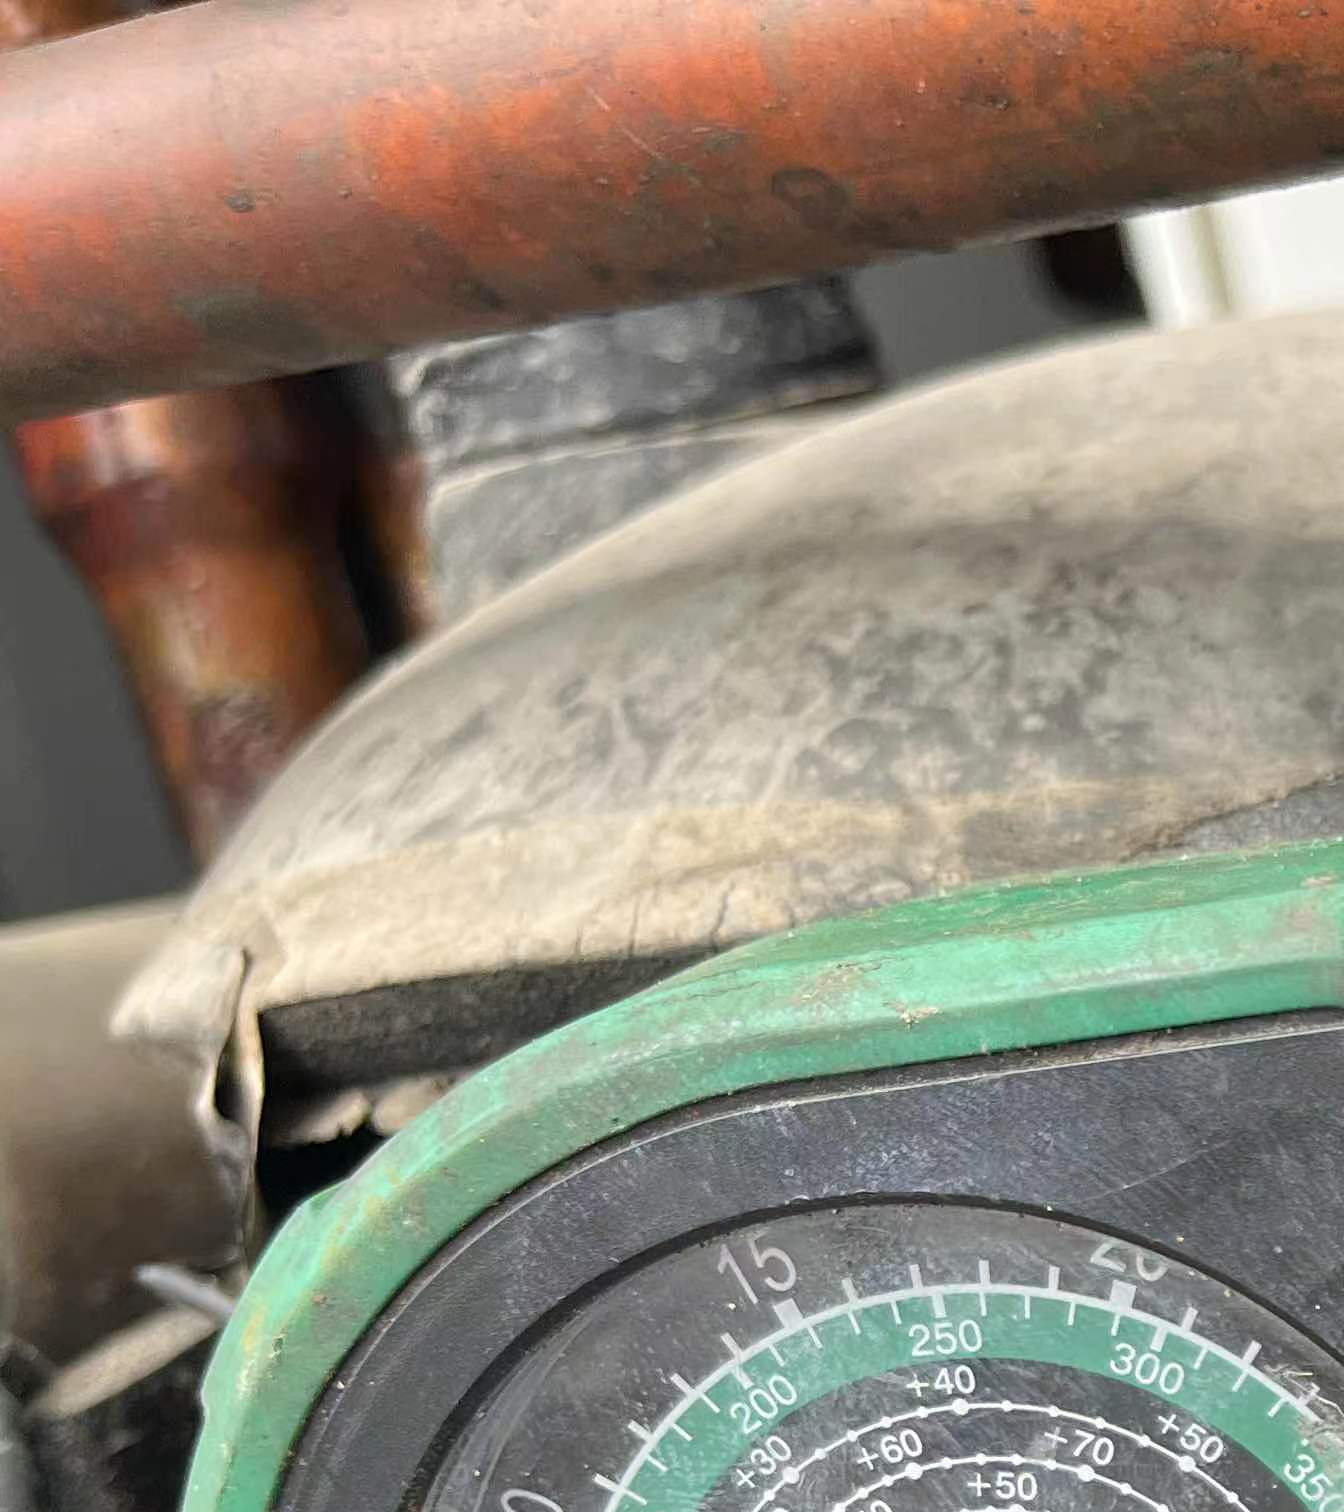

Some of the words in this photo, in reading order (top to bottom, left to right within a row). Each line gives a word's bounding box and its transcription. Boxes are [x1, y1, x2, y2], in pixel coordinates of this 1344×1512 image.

[717, 1238, 797, 1304] 15
[908, 1319, 983, 1357] 250
[906, 1365, 976, 1397] +40
[1110, 1343, 1185, 1395] 300
[730, 1375, 797, 1434] 200
[857, 1429, 923, 1470] +60
[1044, 1427, 1115, 1466] +70
[1157, 1413, 1224, 1464] +50
[736, 1435, 792, 1489] +30
[966, 1472, 1038, 1501] +50
